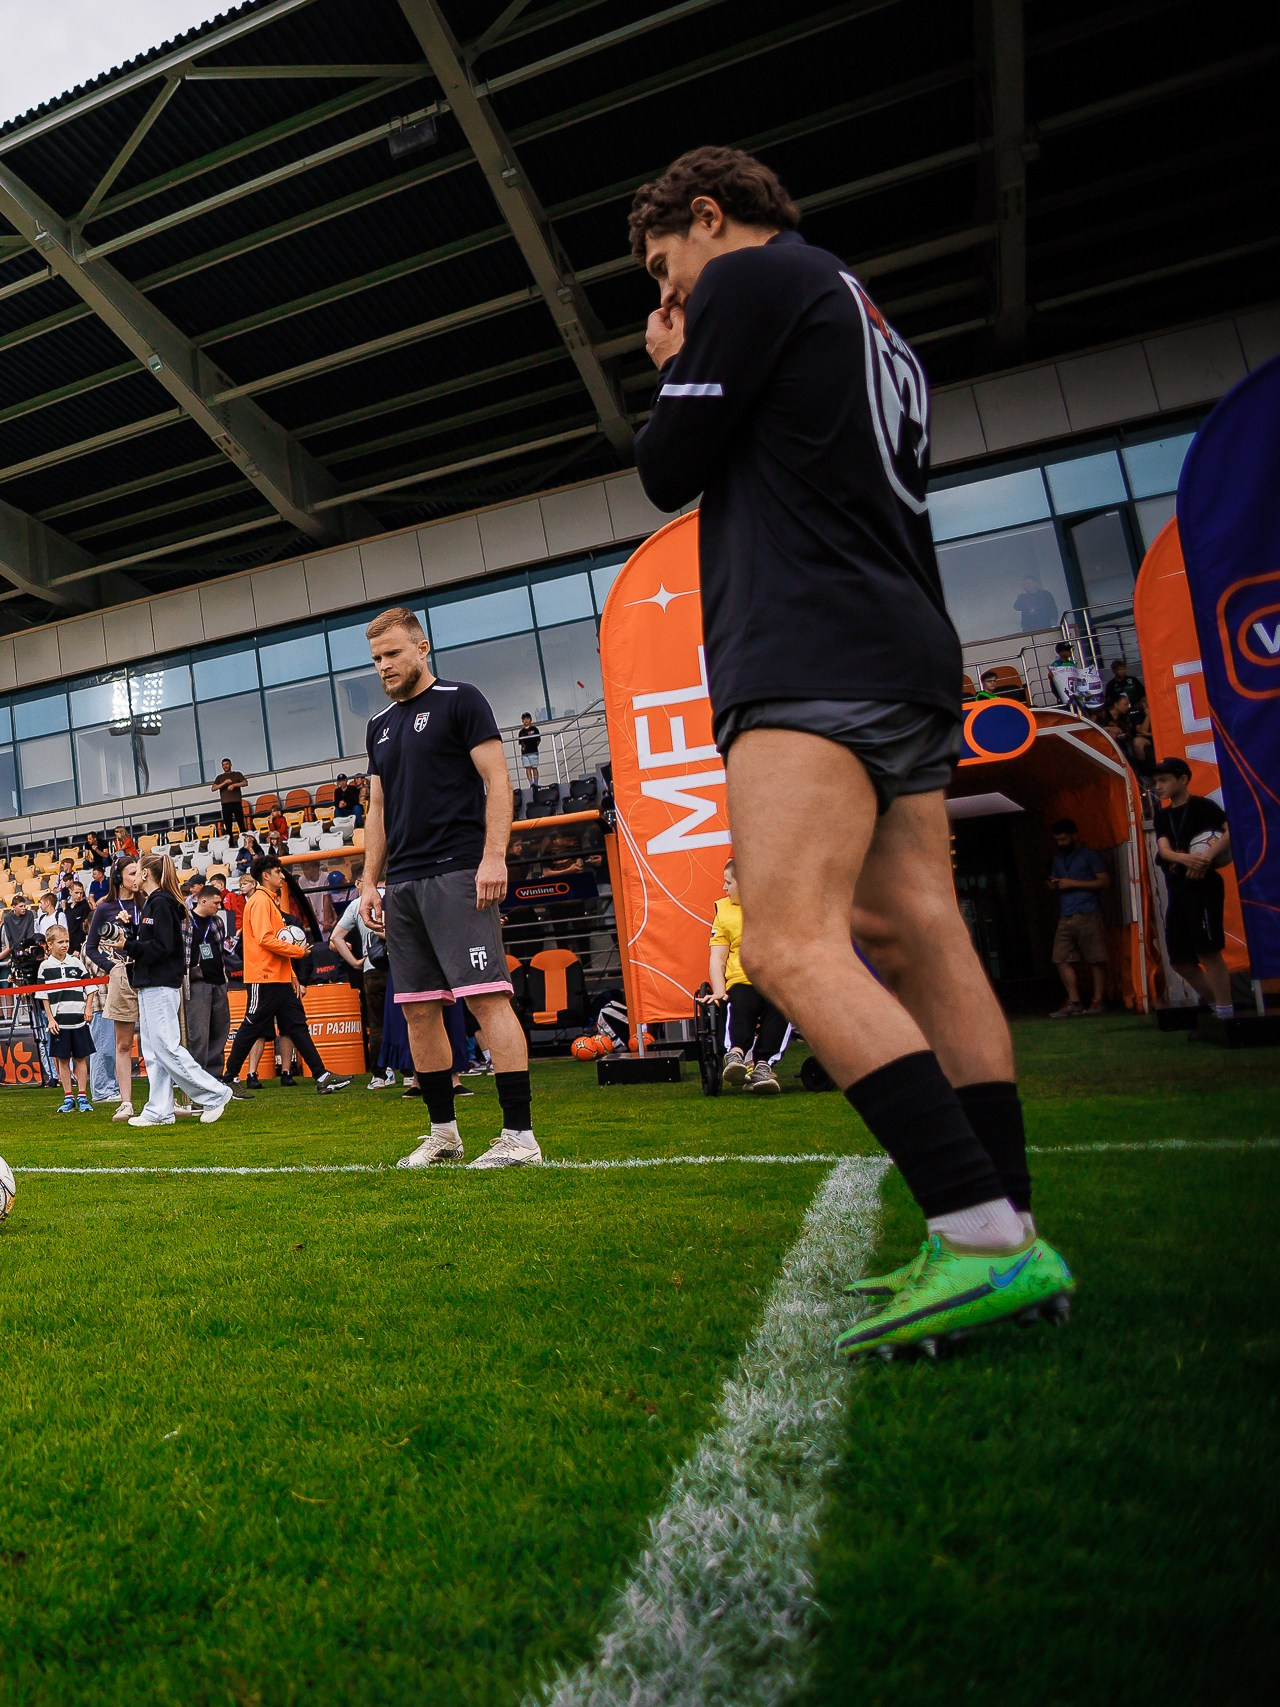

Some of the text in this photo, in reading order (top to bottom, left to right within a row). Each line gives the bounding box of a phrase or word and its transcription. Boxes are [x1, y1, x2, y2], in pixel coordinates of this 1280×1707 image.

[632, 645, 733, 856] MFL
[520, 886, 555, 896] Winline
[469, 951, 487, 970] FC
[307, 1020, 362, 1036] АЕТ РАЗНИЦ
